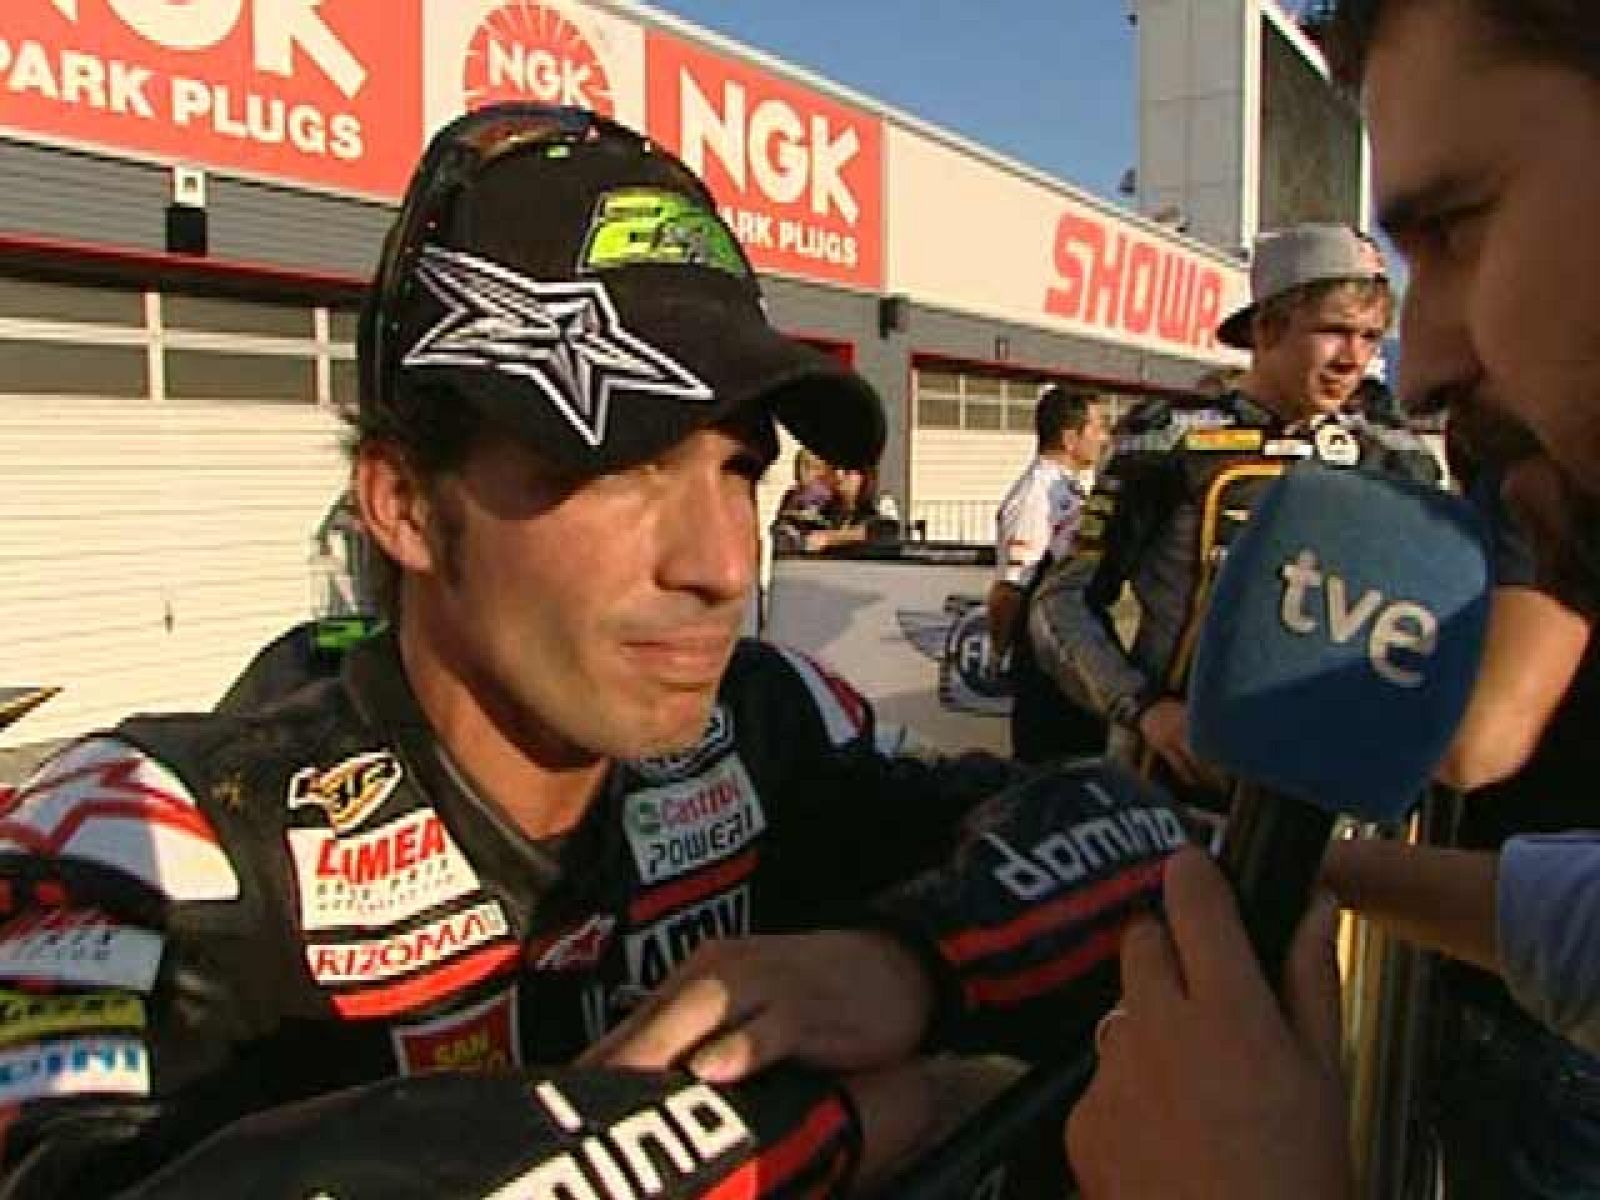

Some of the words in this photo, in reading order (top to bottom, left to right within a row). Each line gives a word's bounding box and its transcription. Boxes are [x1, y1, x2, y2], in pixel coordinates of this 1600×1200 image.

[171, 76, 363, 160] PLUGS
[488, 39, 594, 113] NGK
[679, 64, 861, 228] NGK
[779, 219, 859, 269] PLUGS
[1044, 212, 1222, 350] SHOWA
[1283, 549, 1439, 688] tve
[316, 818, 447, 884] LIMEA
[980, 781, 1189, 900] domino
